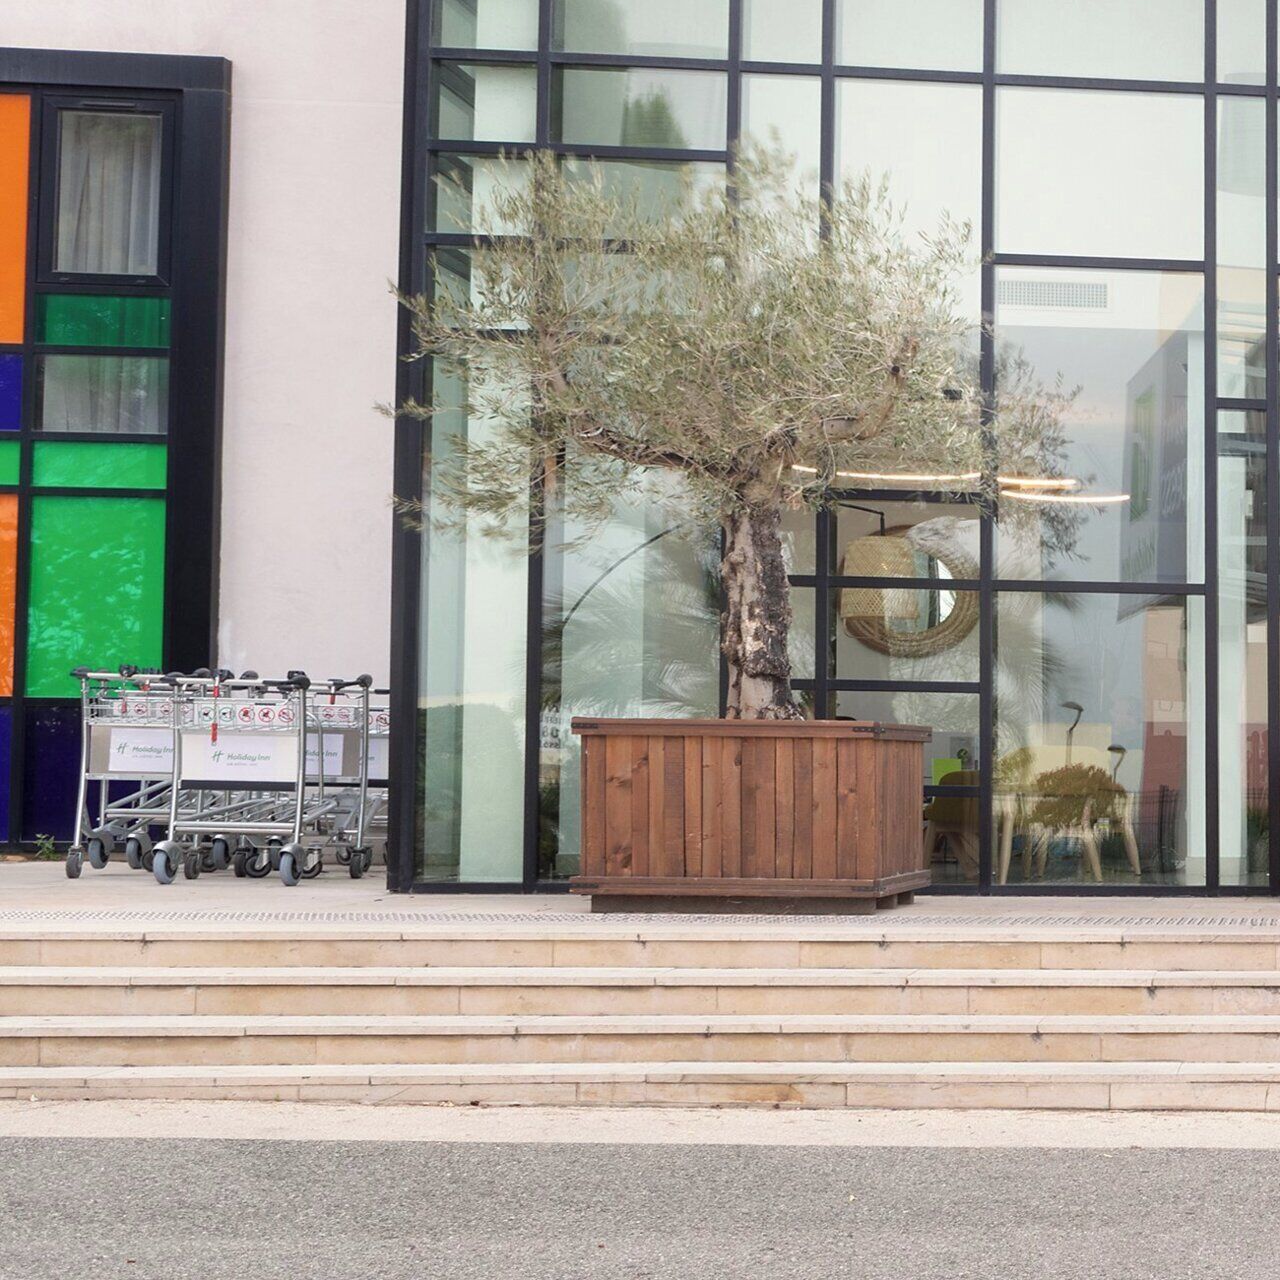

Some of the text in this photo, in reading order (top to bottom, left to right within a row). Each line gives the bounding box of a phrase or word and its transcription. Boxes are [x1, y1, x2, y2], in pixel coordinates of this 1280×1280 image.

[132, 745, 162, 754] Holiday
[227, 753, 257, 762] Holiday
[257, 753, 271, 761] Inn
